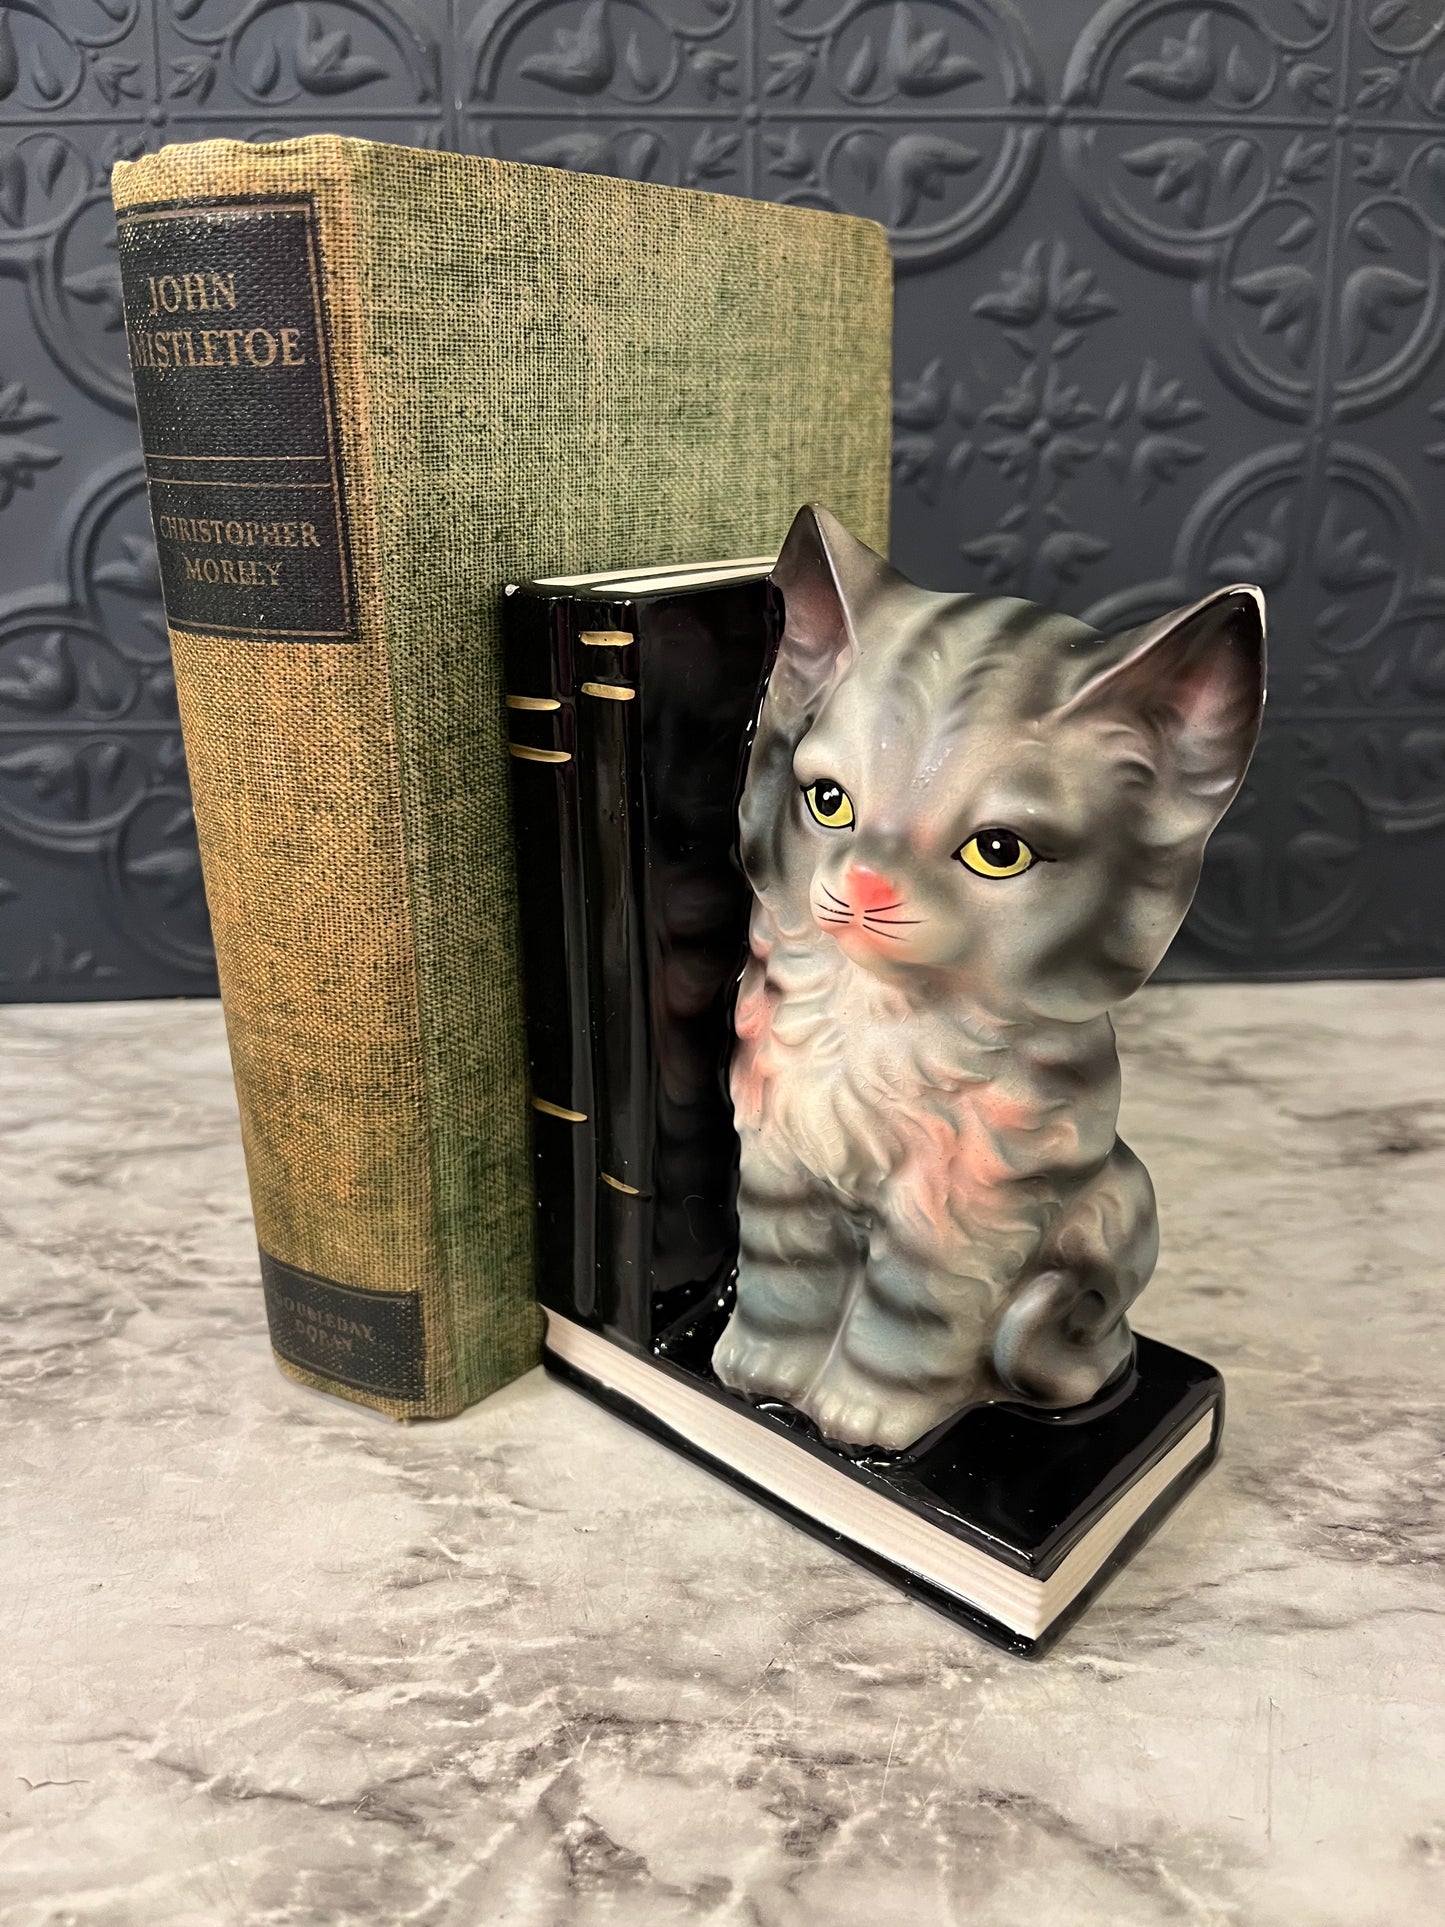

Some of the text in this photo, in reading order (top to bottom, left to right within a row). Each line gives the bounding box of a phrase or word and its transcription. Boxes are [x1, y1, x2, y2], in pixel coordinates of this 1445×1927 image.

[149, 272, 237, 314] JOHN
[159, 514, 321, 547] CHRISTOPHER
[182, 555, 283, 586] MORLEY
